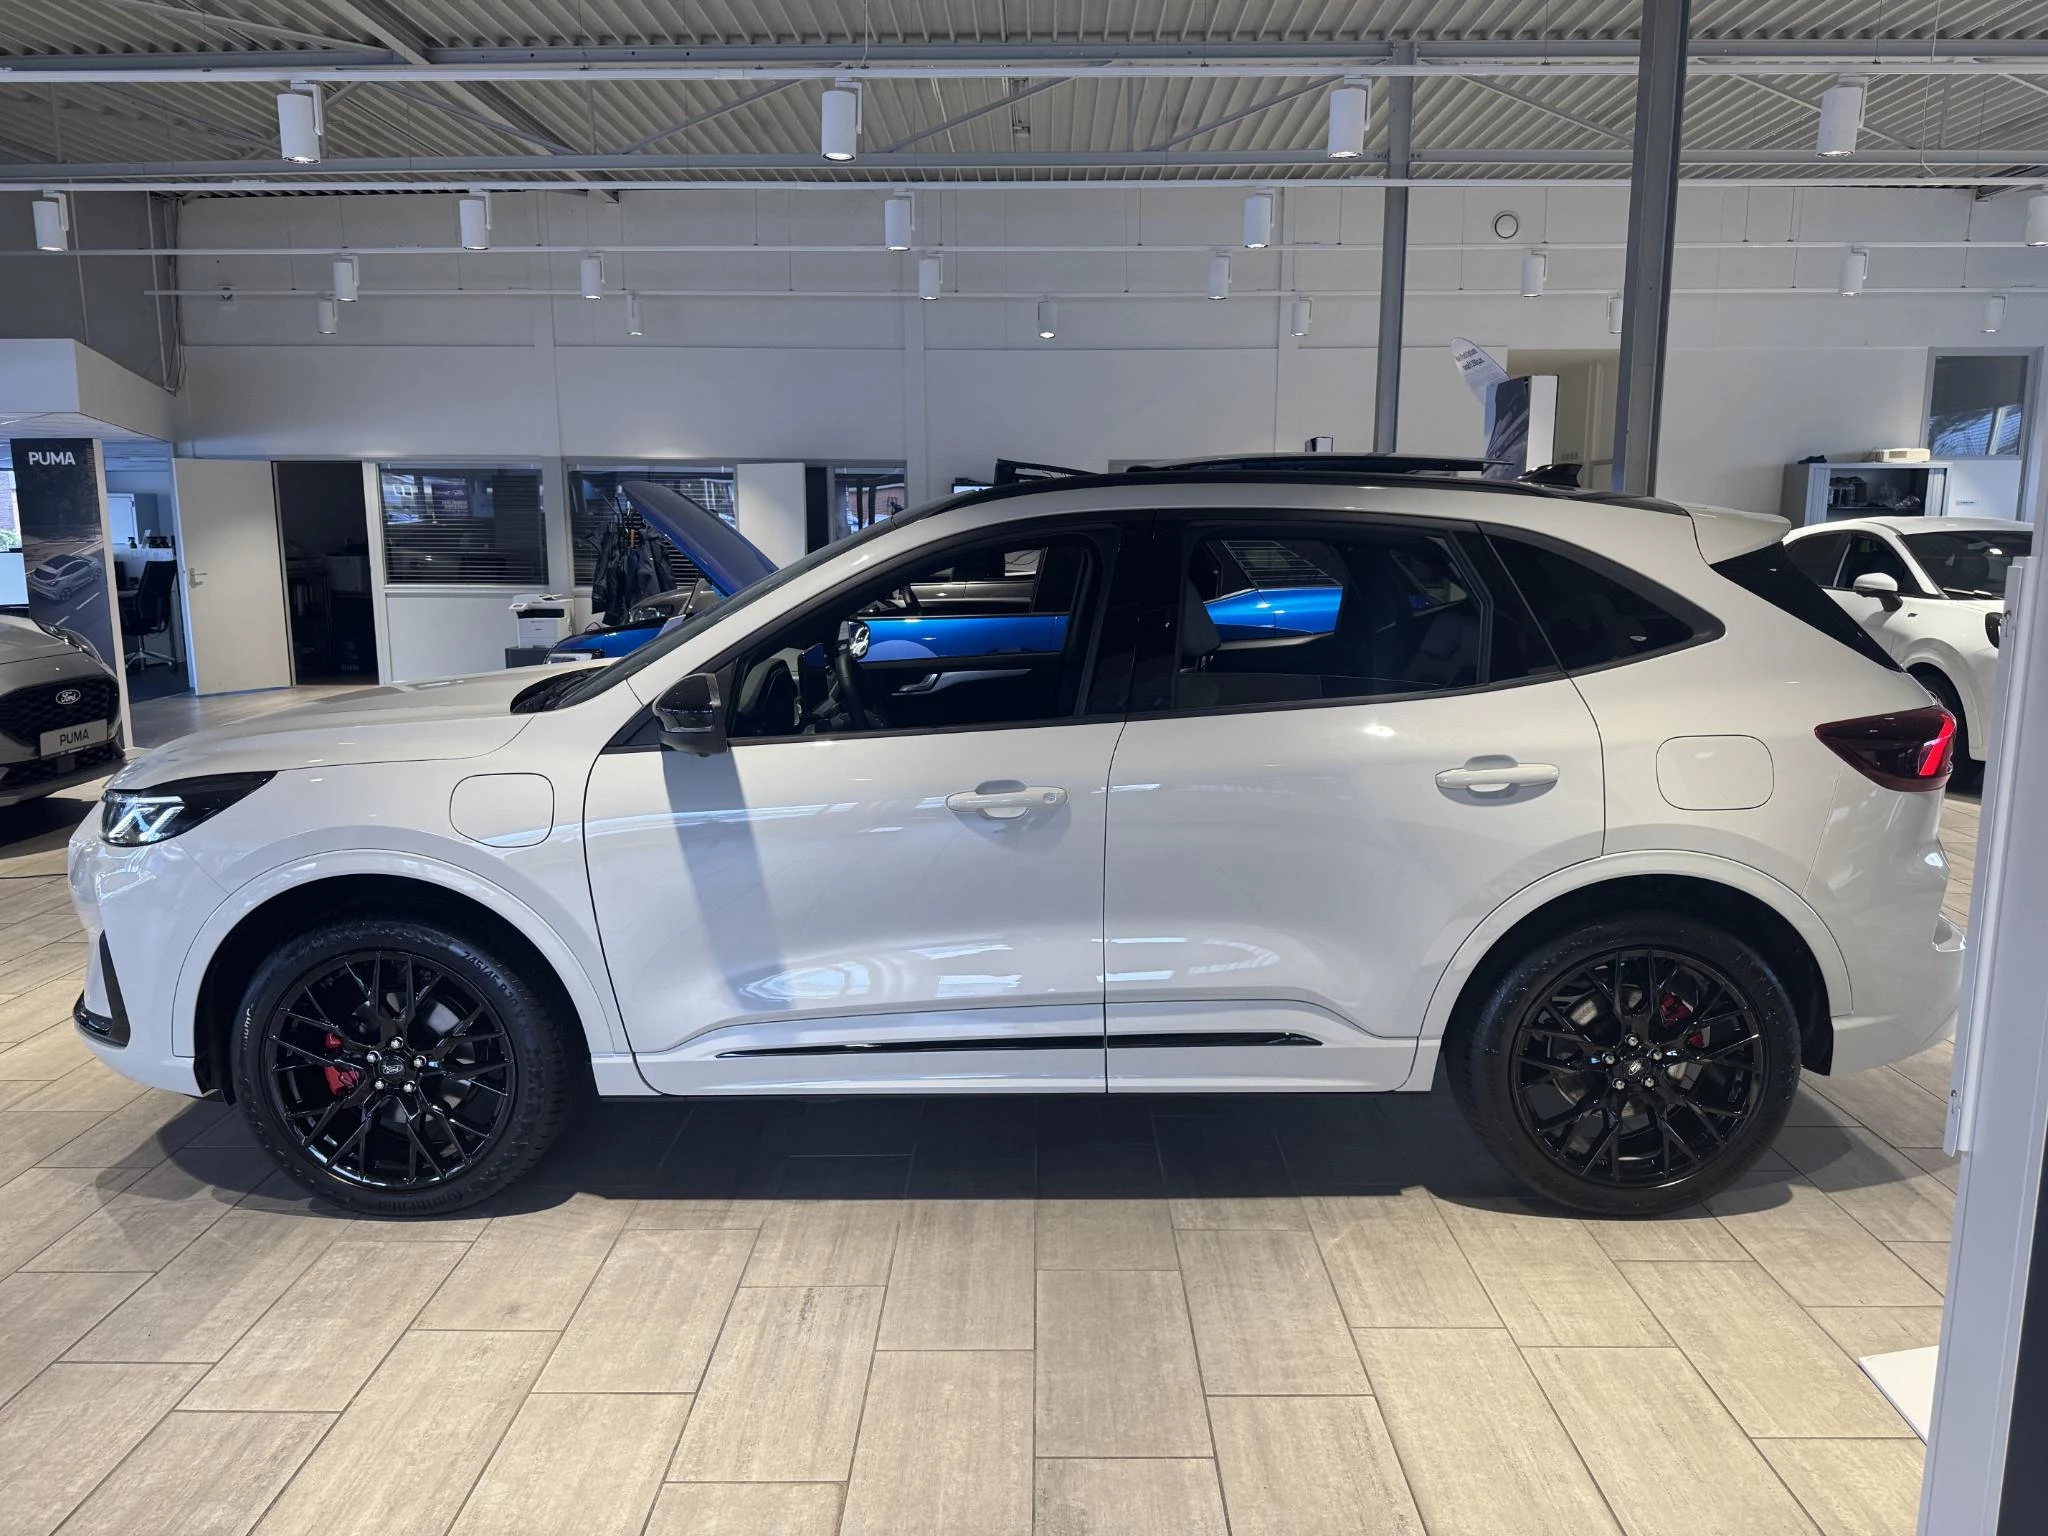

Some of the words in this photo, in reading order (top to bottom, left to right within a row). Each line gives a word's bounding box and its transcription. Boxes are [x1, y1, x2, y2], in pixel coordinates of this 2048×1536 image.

[28, 451, 76, 465] PUMA
[59, 690, 79, 703] Ford
[59, 728, 90, 746] PUMA
